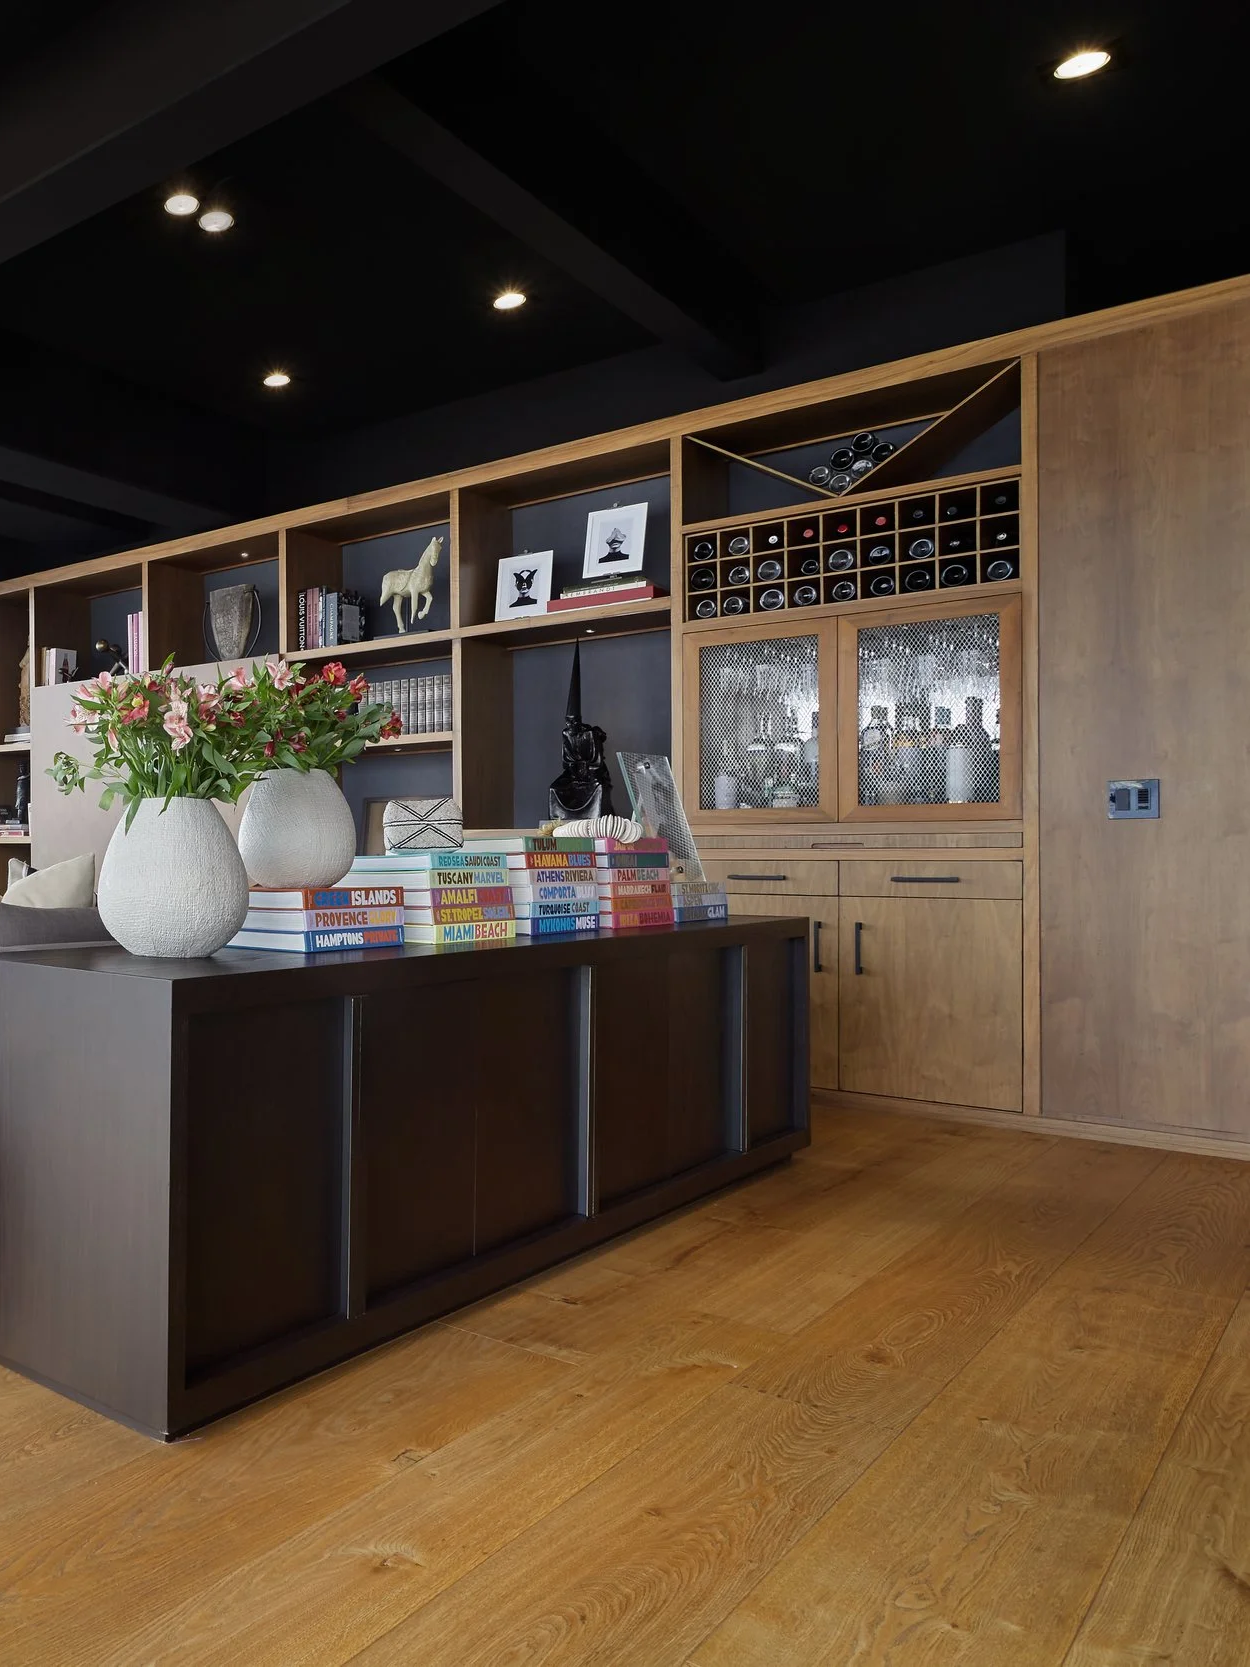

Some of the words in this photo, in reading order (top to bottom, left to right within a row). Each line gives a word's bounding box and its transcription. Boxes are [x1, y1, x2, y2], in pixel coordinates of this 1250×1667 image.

[298, 594, 306, 616] LOUIS
[298, 616, 306, 648] VUITTON
[533, 838, 557, 851] TULUM
[438, 856, 451, 867] RED
[451, 856, 464, 867] SEA
[464, 856, 482, 867] SAUDI
[483, 856, 501, 867] COAST
[533, 854, 568, 867] HAVANA
[568, 854, 591, 867] BLUES
[437, 872, 473, 885] TUSCANY
[474, 871, 504, 884] MARVEL
[536, 870, 565, 883] ATHENS
[565, 870, 594, 882] RIVIERA
[617, 869, 637, 881] PALM
[637, 869, 659, 880] BEACH
[440, 888, 478, 905] AMALFI
[539, 886, 576, 900] COMPORTA
[617, 884, 652, 896] MARRAKECH
[351, 889, 397, 906] ISLANDS
[538, 904, 570, 916] TURQUOISE
[571, 902, 590, 913] COAST
[707, 906, 725, 918] GLAM
[314, 911, 369, 928] PROVENCE
[369, 910, 397, 925] GLORY
[539, 918, 576, 933] MYKONOS
[575, 915, 596, 930] MUSE
[639, 911, 670, 925] BOHEMIA
[443, 924, 474, 942] MIAMI
[475, 922, 508, 939] BEACH
[315, 932, 364, 948] HAMPTONS
